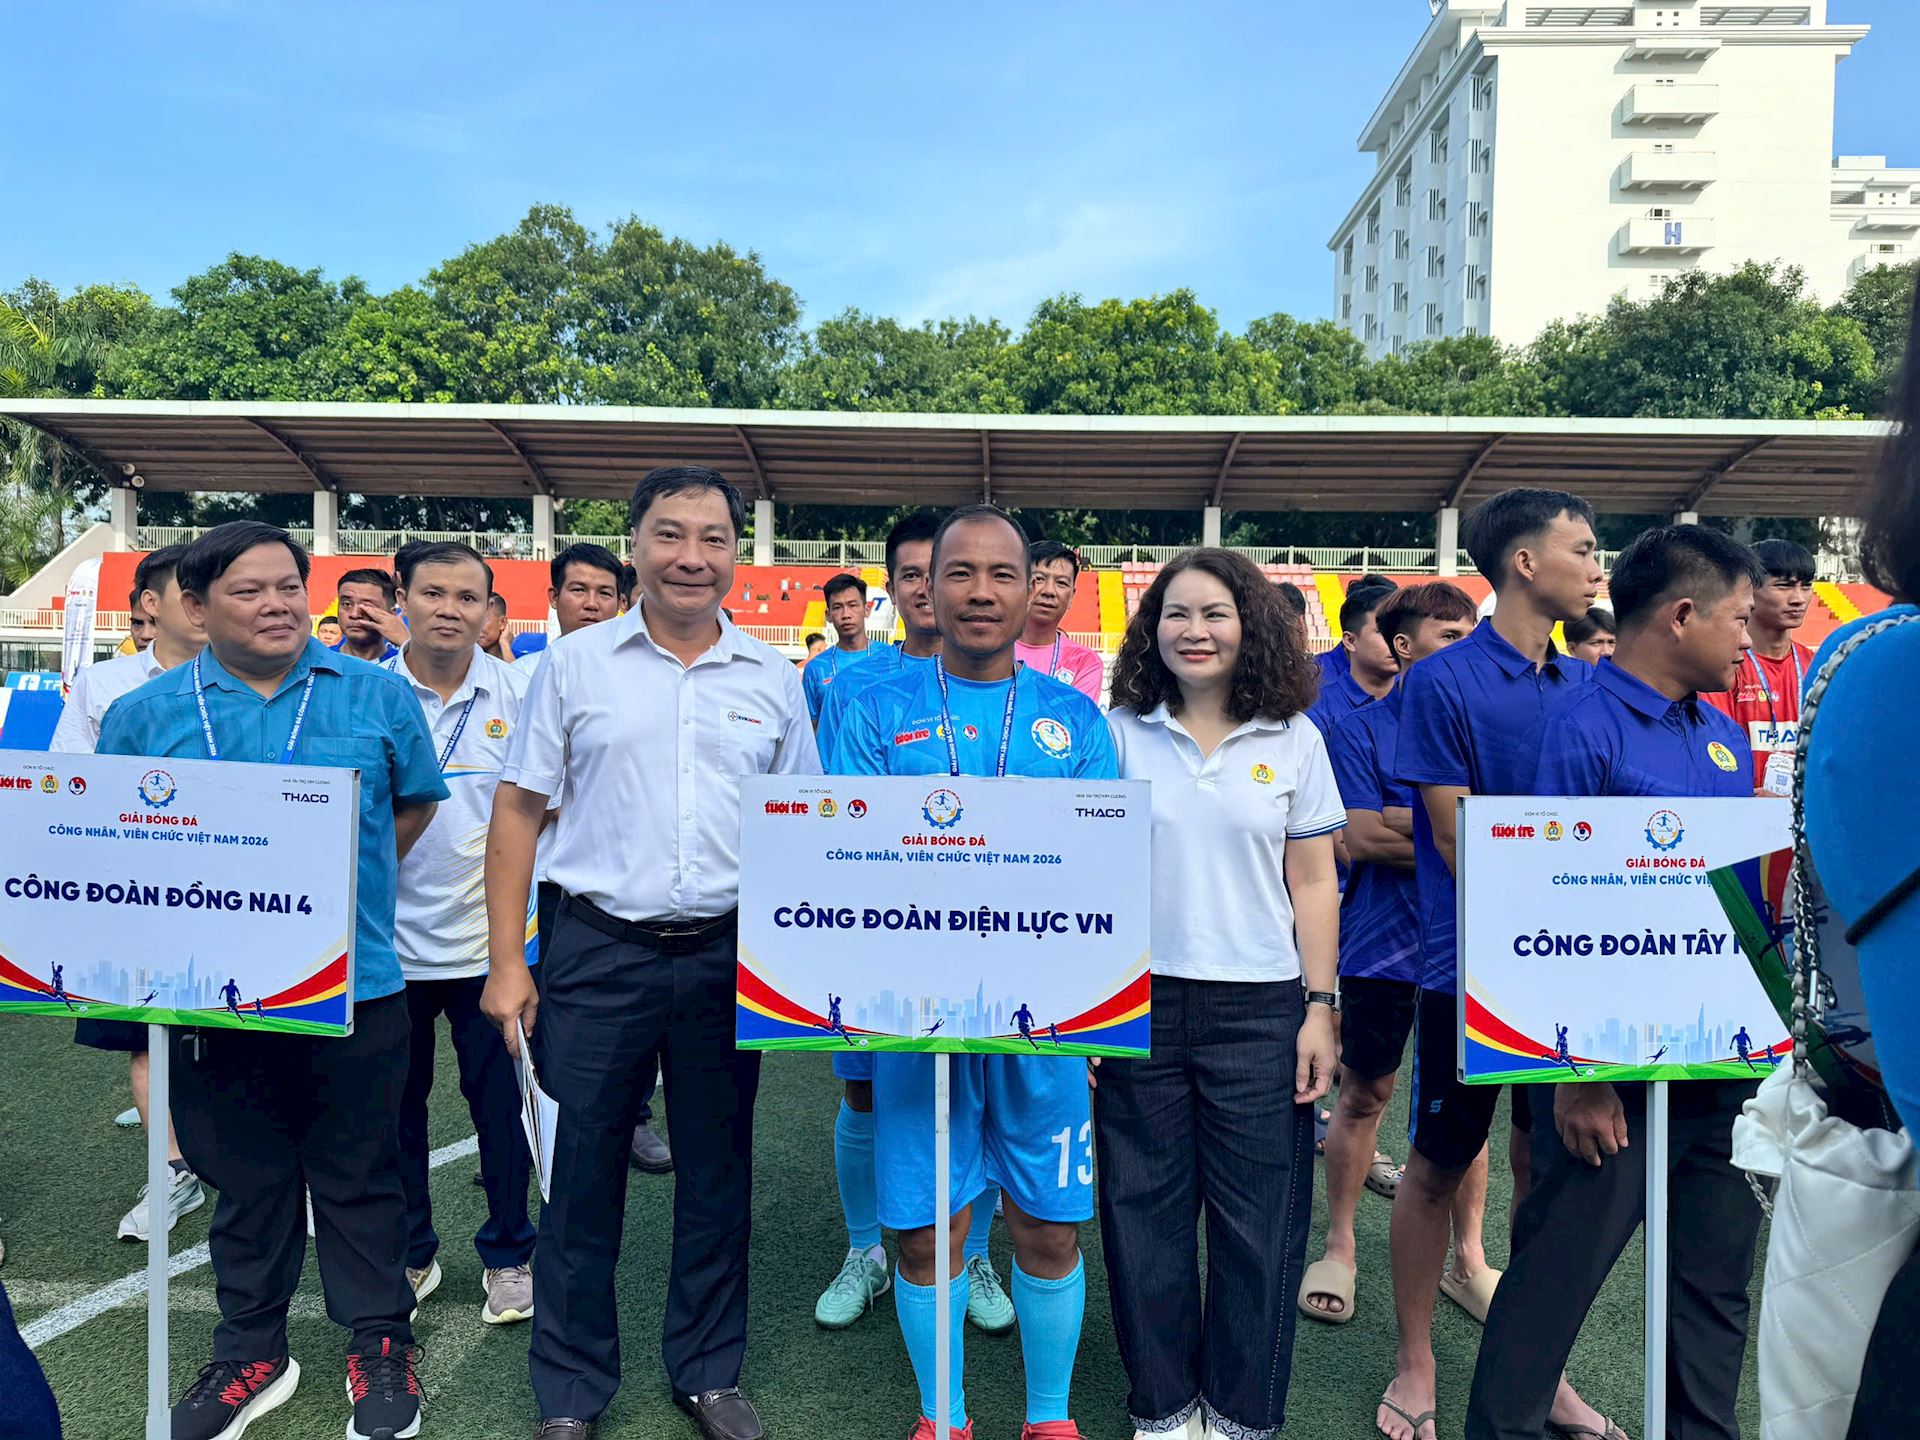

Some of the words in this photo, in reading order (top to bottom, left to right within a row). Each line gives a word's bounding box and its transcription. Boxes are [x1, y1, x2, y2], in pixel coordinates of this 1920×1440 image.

[1664, 222, 1682, 245] H
[282, 792, 329, 804] THACO
[119, 811, 142, 823] GIẢI
[146, 813, 179, 825] BÓNG
[182, 815, 198, 827] ĐÁ
[1075, 807, 1125, 818] THACO
[48, 823, 82, 836] CÔNG
[85, 826, 120, 839] NHÂN,
[123, 828, 149, 840] VIÊN
[151, 830, 183, 842] CHỨC
[187, 832, 211, 845] VIỆT
[213, 835, 239, 845] NAM
[241, 836, 269, 847] 2026
[902, 832, 928, 845] GIẢI
[930, 834, 966, 846] BÓNG
[969, 834, 986, 846] ĐÁ
[826, 848, 863, 861] CÔNG
[866, 849, 903, 863] NHÂN,
[906, 850, 934, 862] VIÊN
[936, 850, 971, 862] CHỨC
[974, 851, 1000, 866] VIỆT
[1003, 853, 1030, 864] NAM
[1033, 854, 1062, 864] 2026
[1626, 856, 1651, 868] GIẢI
[1654, 855, 1687, 868] BÓNG
[1690, 856, 1705, 868] ĐÁ
[1552, 873, 1588, 885] CÔNG
[1591, 873, 1627, 887] NHÂN,
[1630, 873, 1657, 885] VIÊN
[1659, 872, 1693, 885] CHỨC
[5, 873, 80, 901] CÔNG
[86, 880, 159, 906] ĐOÀN
[165, 881, 243, 911] ĐỒNG
[249, 892, 291, 914] NAI
[297, 895, 313, 915] 4
[774, 901, 856, 929] CÔNG
[862, 903, 941, 931] ĐOÀN
[948, 905, 1010, 938] ĐIỆN
[1017, 910, 1069, 940] LỰC
[1076, 913, 1113, 935] VN
[1513, 929, 1594, 957] CÔNG
[1600, 929, 1676, 956] ĐOÀN
[1682, 928, 1727, 955] TÂY
[1051, 1120, 1092, 1188] 13
